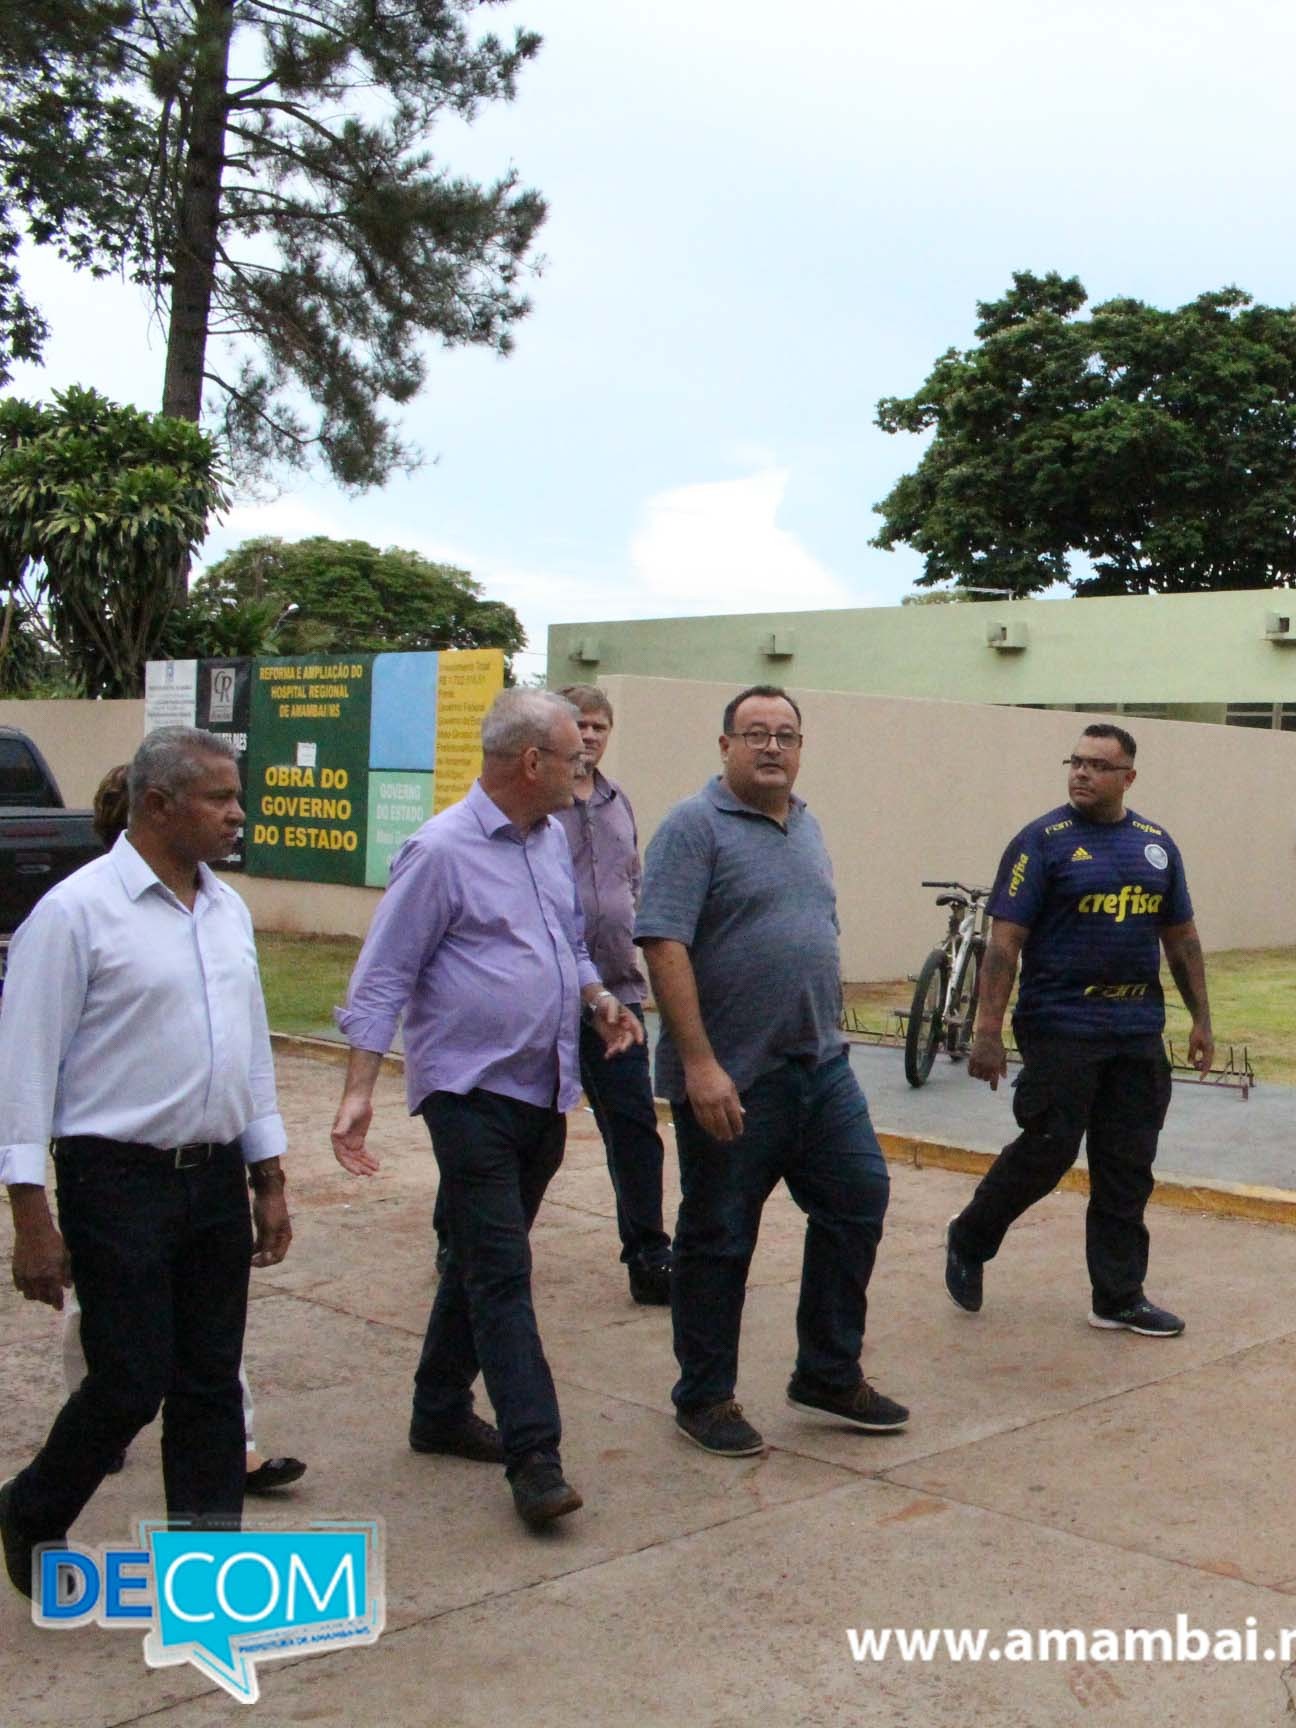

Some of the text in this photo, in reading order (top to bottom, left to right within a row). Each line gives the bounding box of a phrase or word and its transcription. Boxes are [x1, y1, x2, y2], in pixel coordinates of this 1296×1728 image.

[309, 684, 349, 698] REGIONAL
[265, 766, 348, 789] OBRA DO
[262, 796, 351, 820] GOVERNO
[254, 825, 279, 845] DO
[284, 827, 358, 851] ESTADO
[1008, 853, 1029, 897] crefisa
[1078, 885, 1163, 922] crefisa
